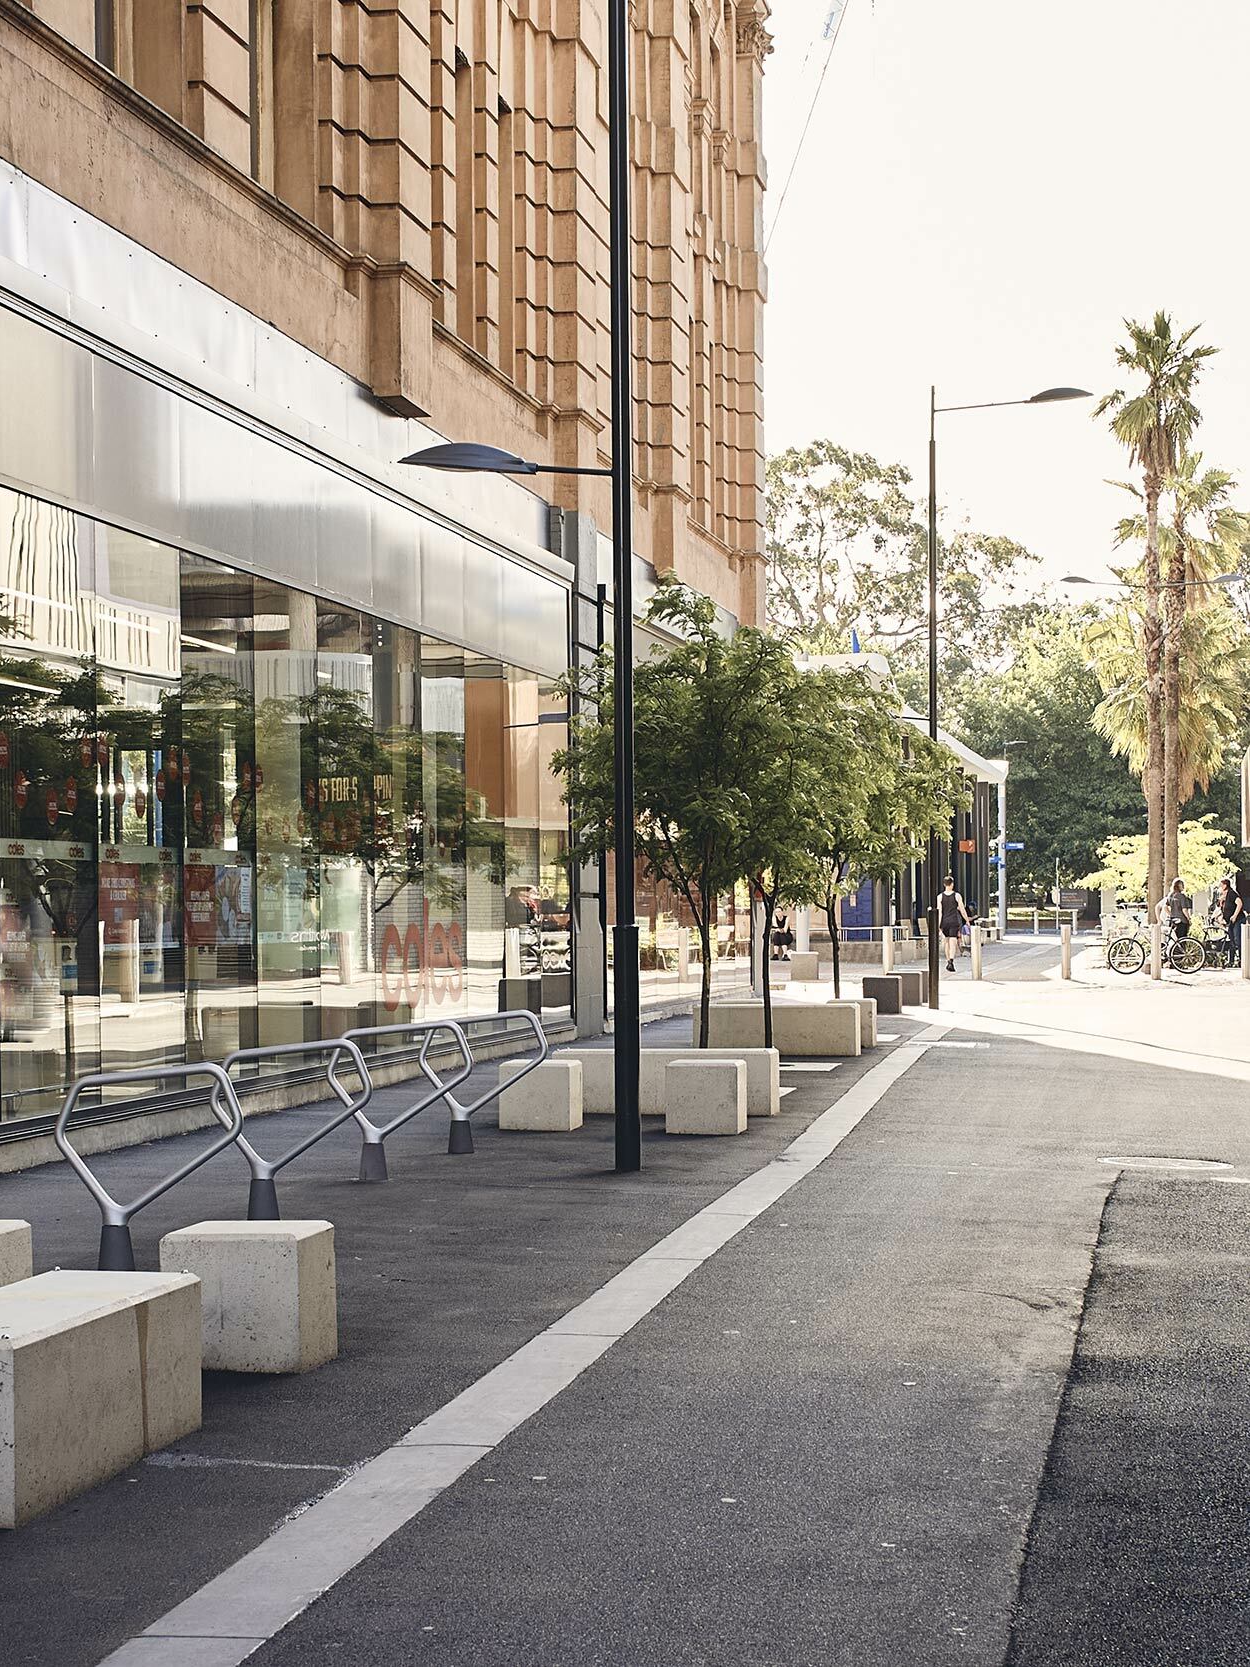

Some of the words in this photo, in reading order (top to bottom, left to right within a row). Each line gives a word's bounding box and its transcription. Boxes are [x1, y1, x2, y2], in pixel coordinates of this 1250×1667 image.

[331, 777, 349, 801] FOR
[8, 841, 25, 856] coles
[68, 844, 85, 859] coles
[159, 848, 173, 862] coles
[382, 896, 463, 1012] coles
